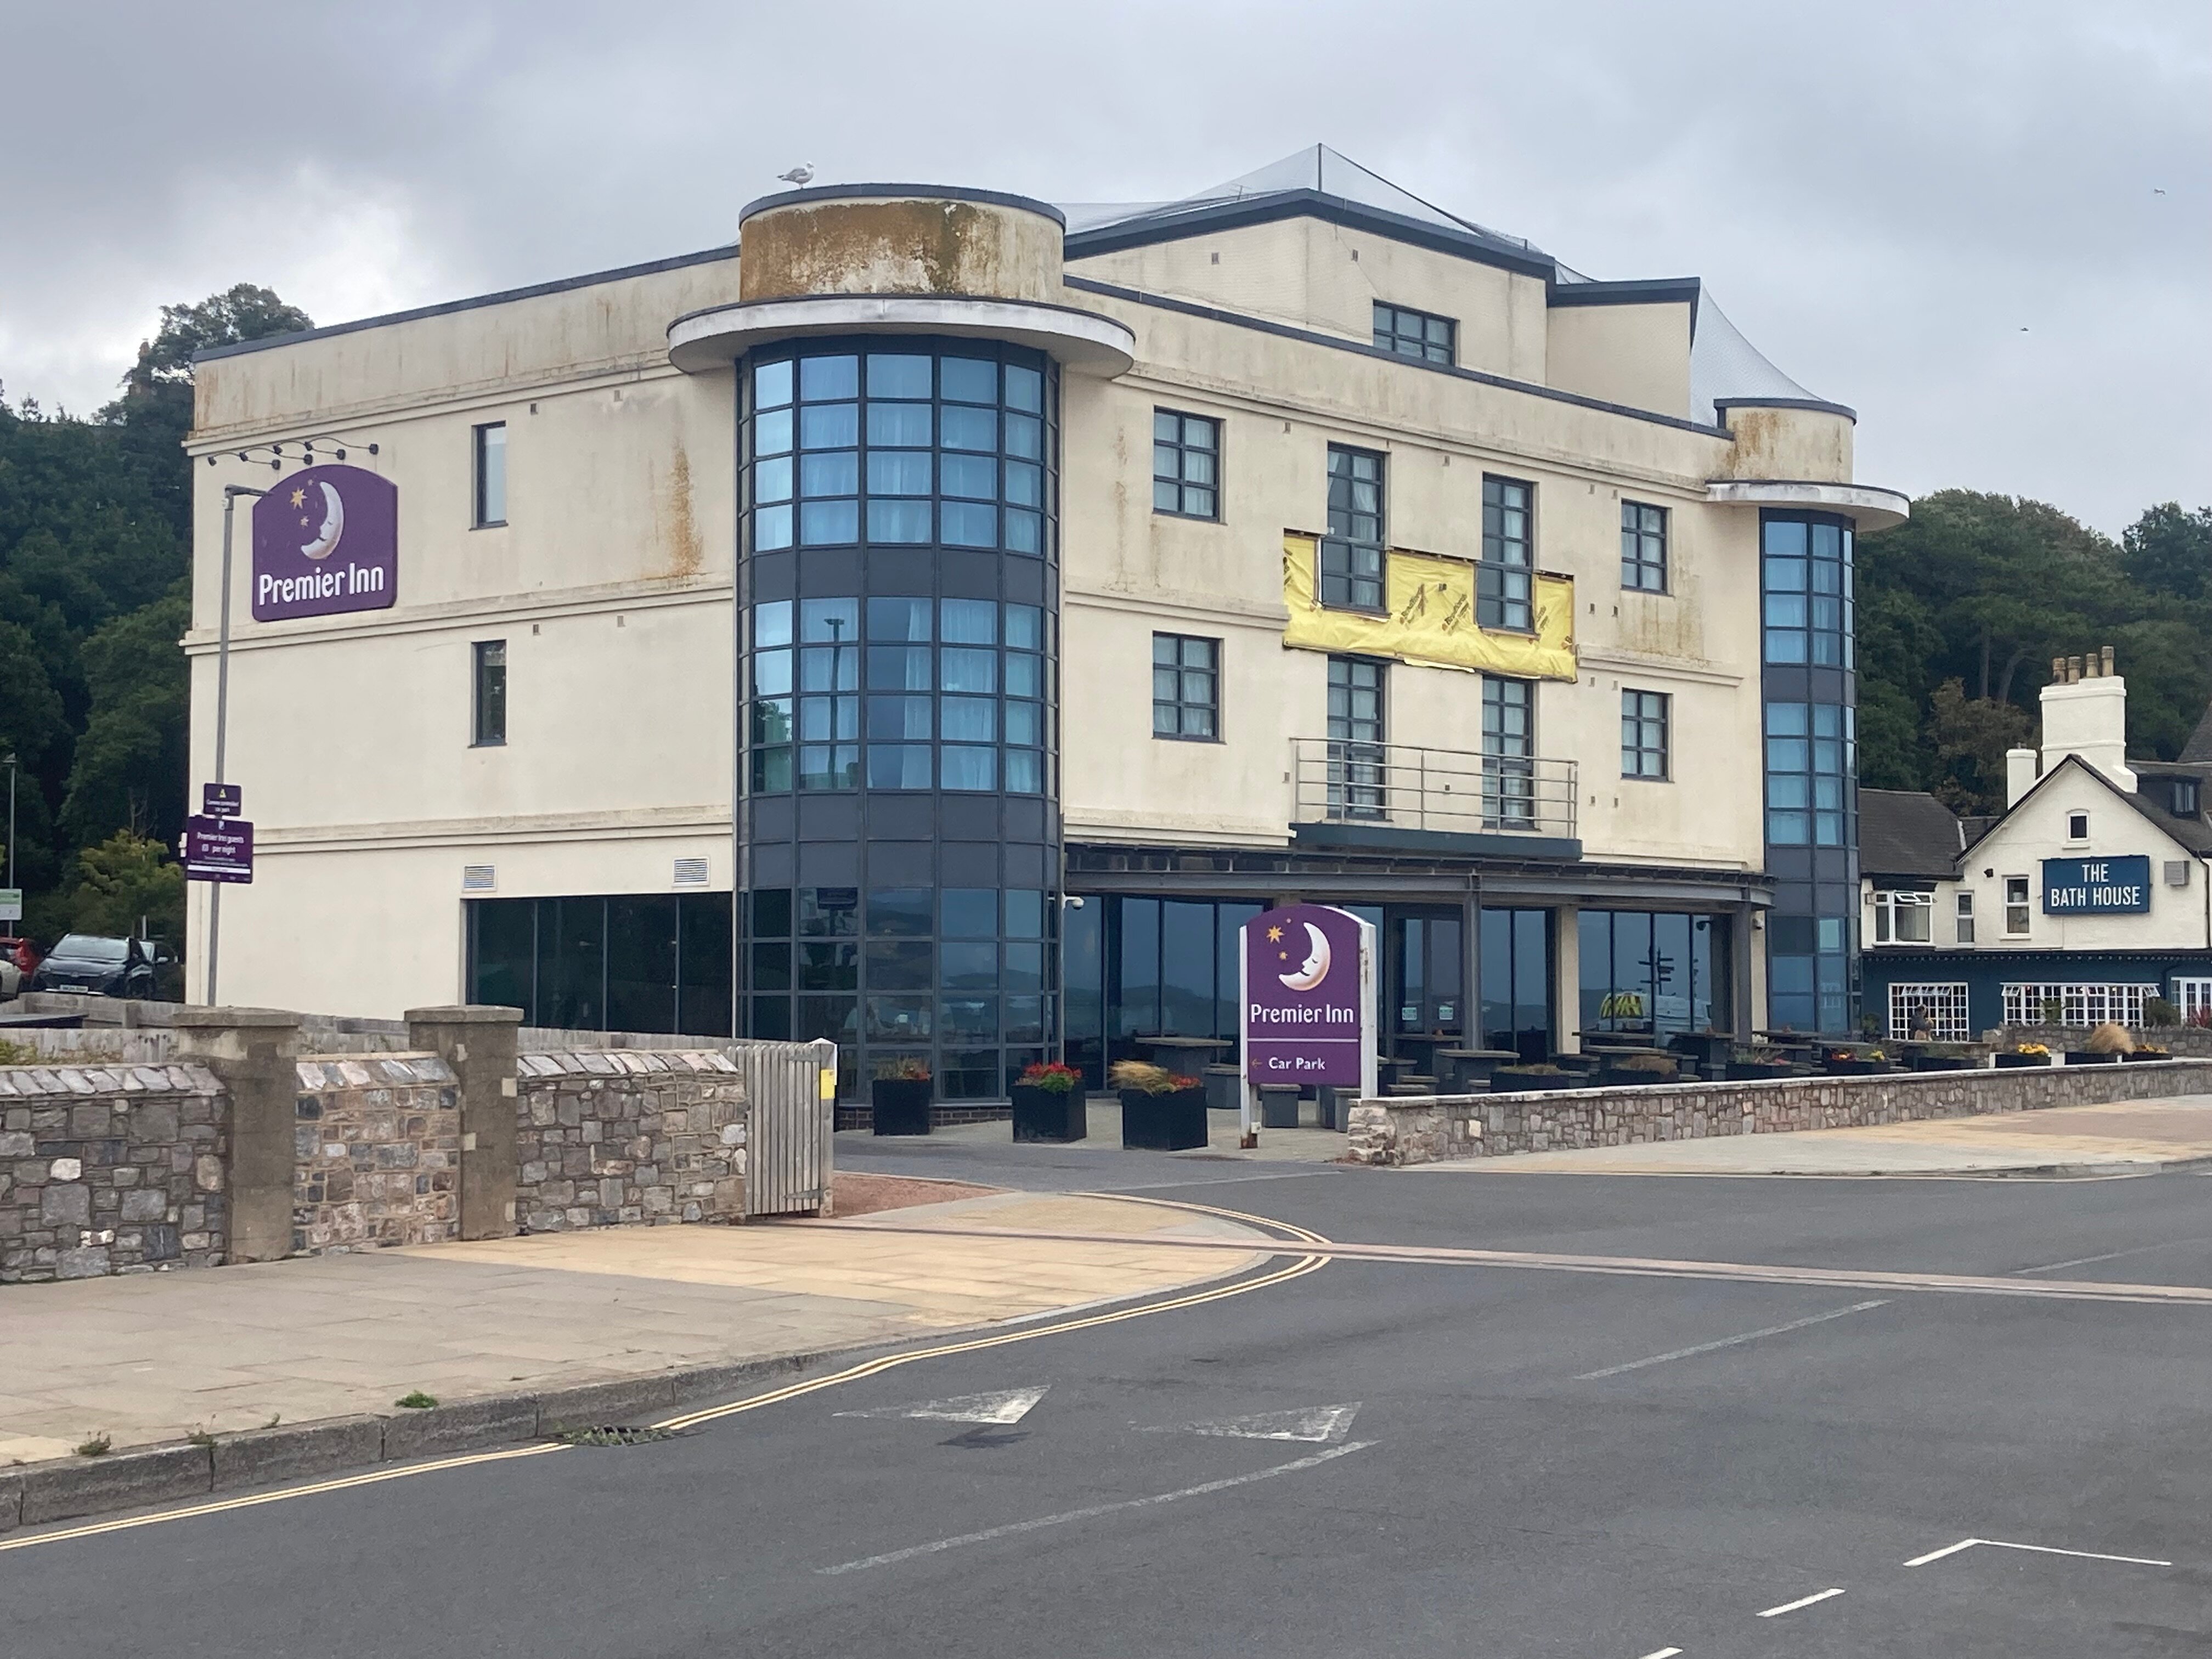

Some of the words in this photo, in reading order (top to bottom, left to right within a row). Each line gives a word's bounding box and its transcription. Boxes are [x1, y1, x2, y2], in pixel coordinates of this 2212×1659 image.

[258, 566, 346, 606] Premier
[349, 562, 384, 595] Inn
[2081, 863, 2109, 883] THE
[2051, 887, 2086, 907] BATH
[2092, 885, 2140, 906] HOUSE
[1250, 1003, 1322, 1024] Premier
[1326, 1003, 1354, 1024] Inn
[1268, 1056, 1292, 1070] Car
[1295, 1056, 1326, 1070] Park
